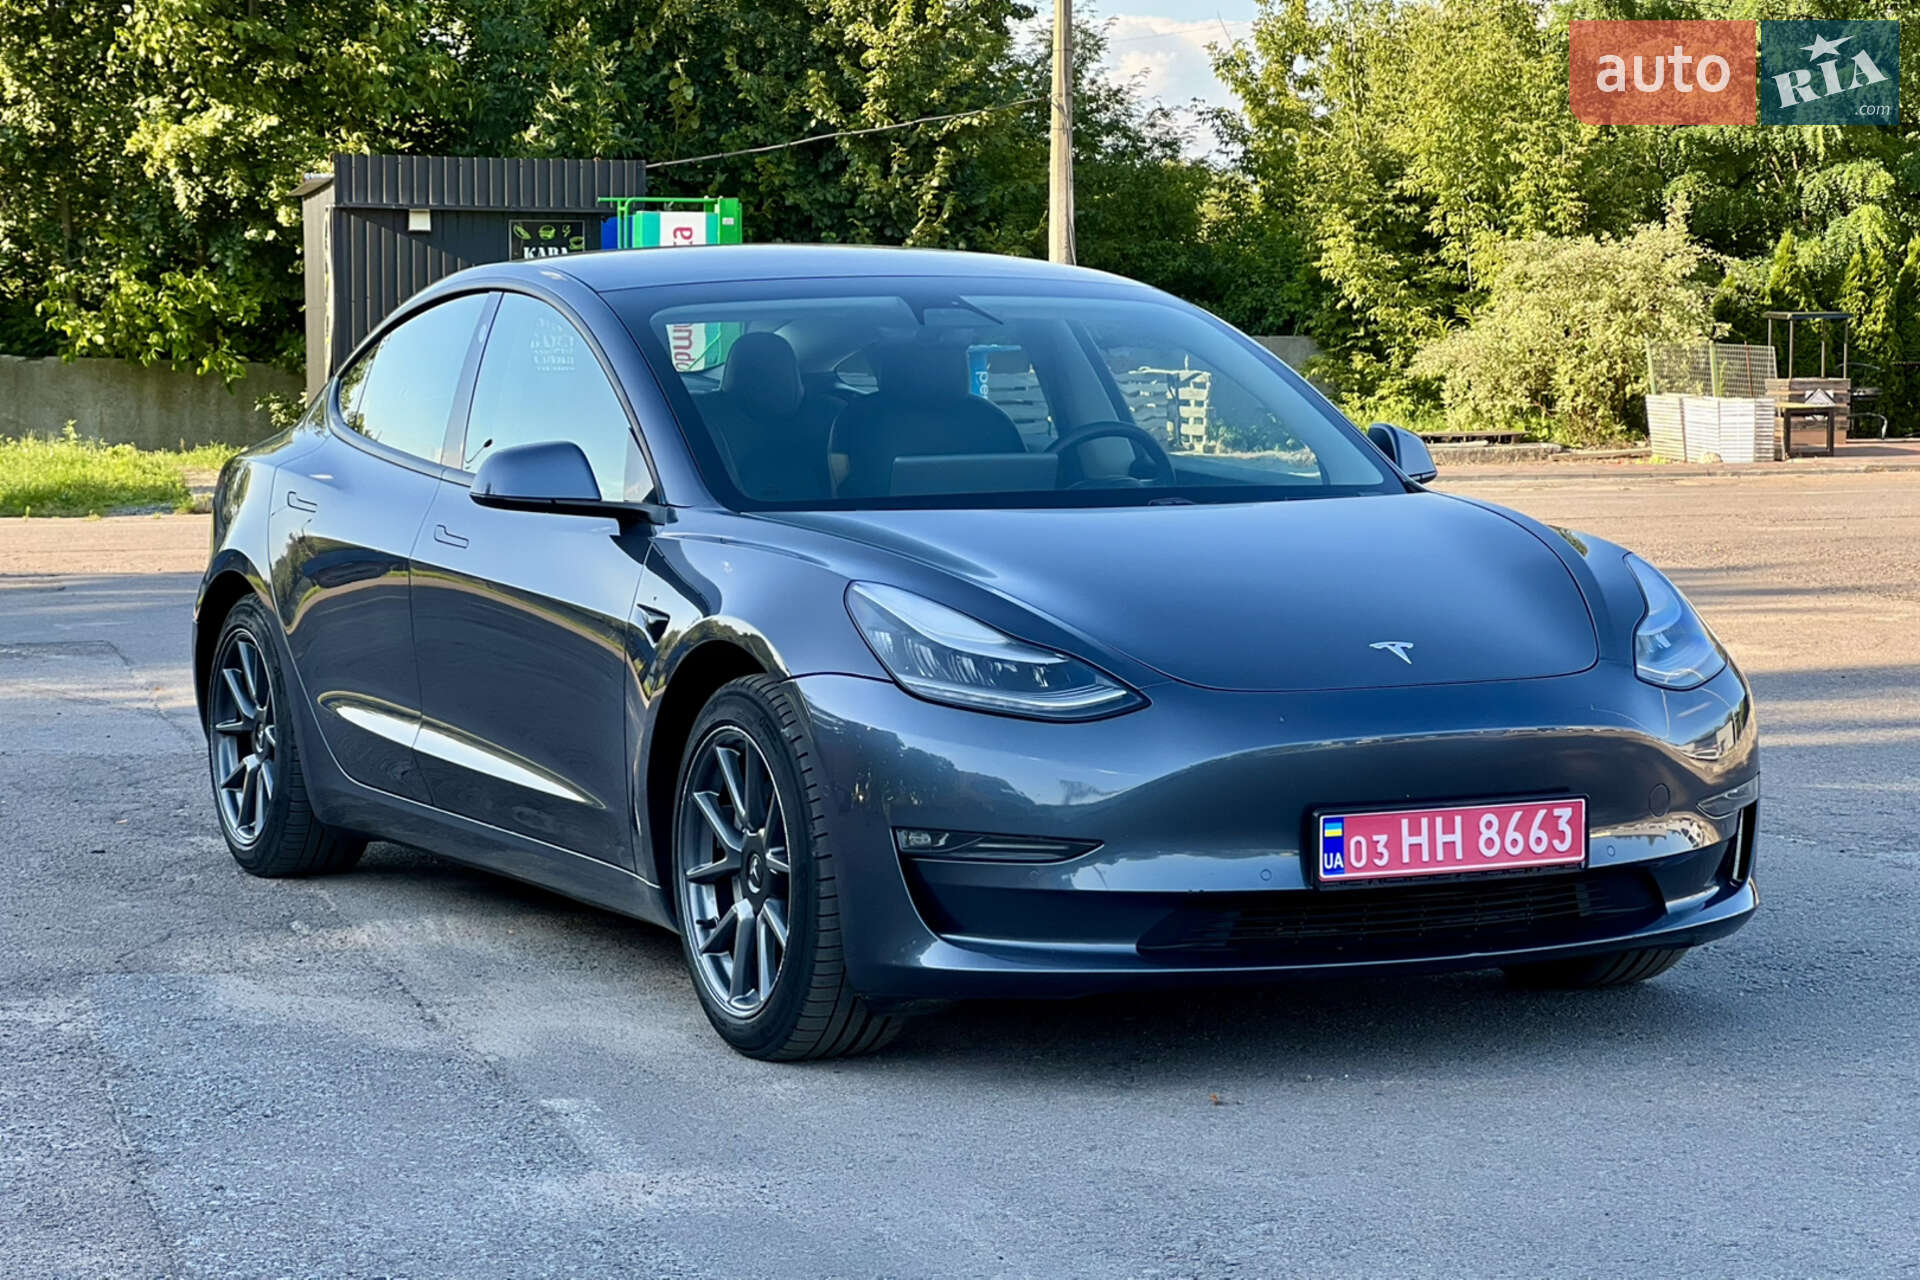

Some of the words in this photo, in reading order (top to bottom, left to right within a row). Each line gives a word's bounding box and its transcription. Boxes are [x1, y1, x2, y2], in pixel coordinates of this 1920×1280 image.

[1349, 834, 1390, 868] 03
[1400, 815, 1463, 864] HH
[1478, 807, 1573, 858] 8663
[1323, 851, 1345, 869] UA
